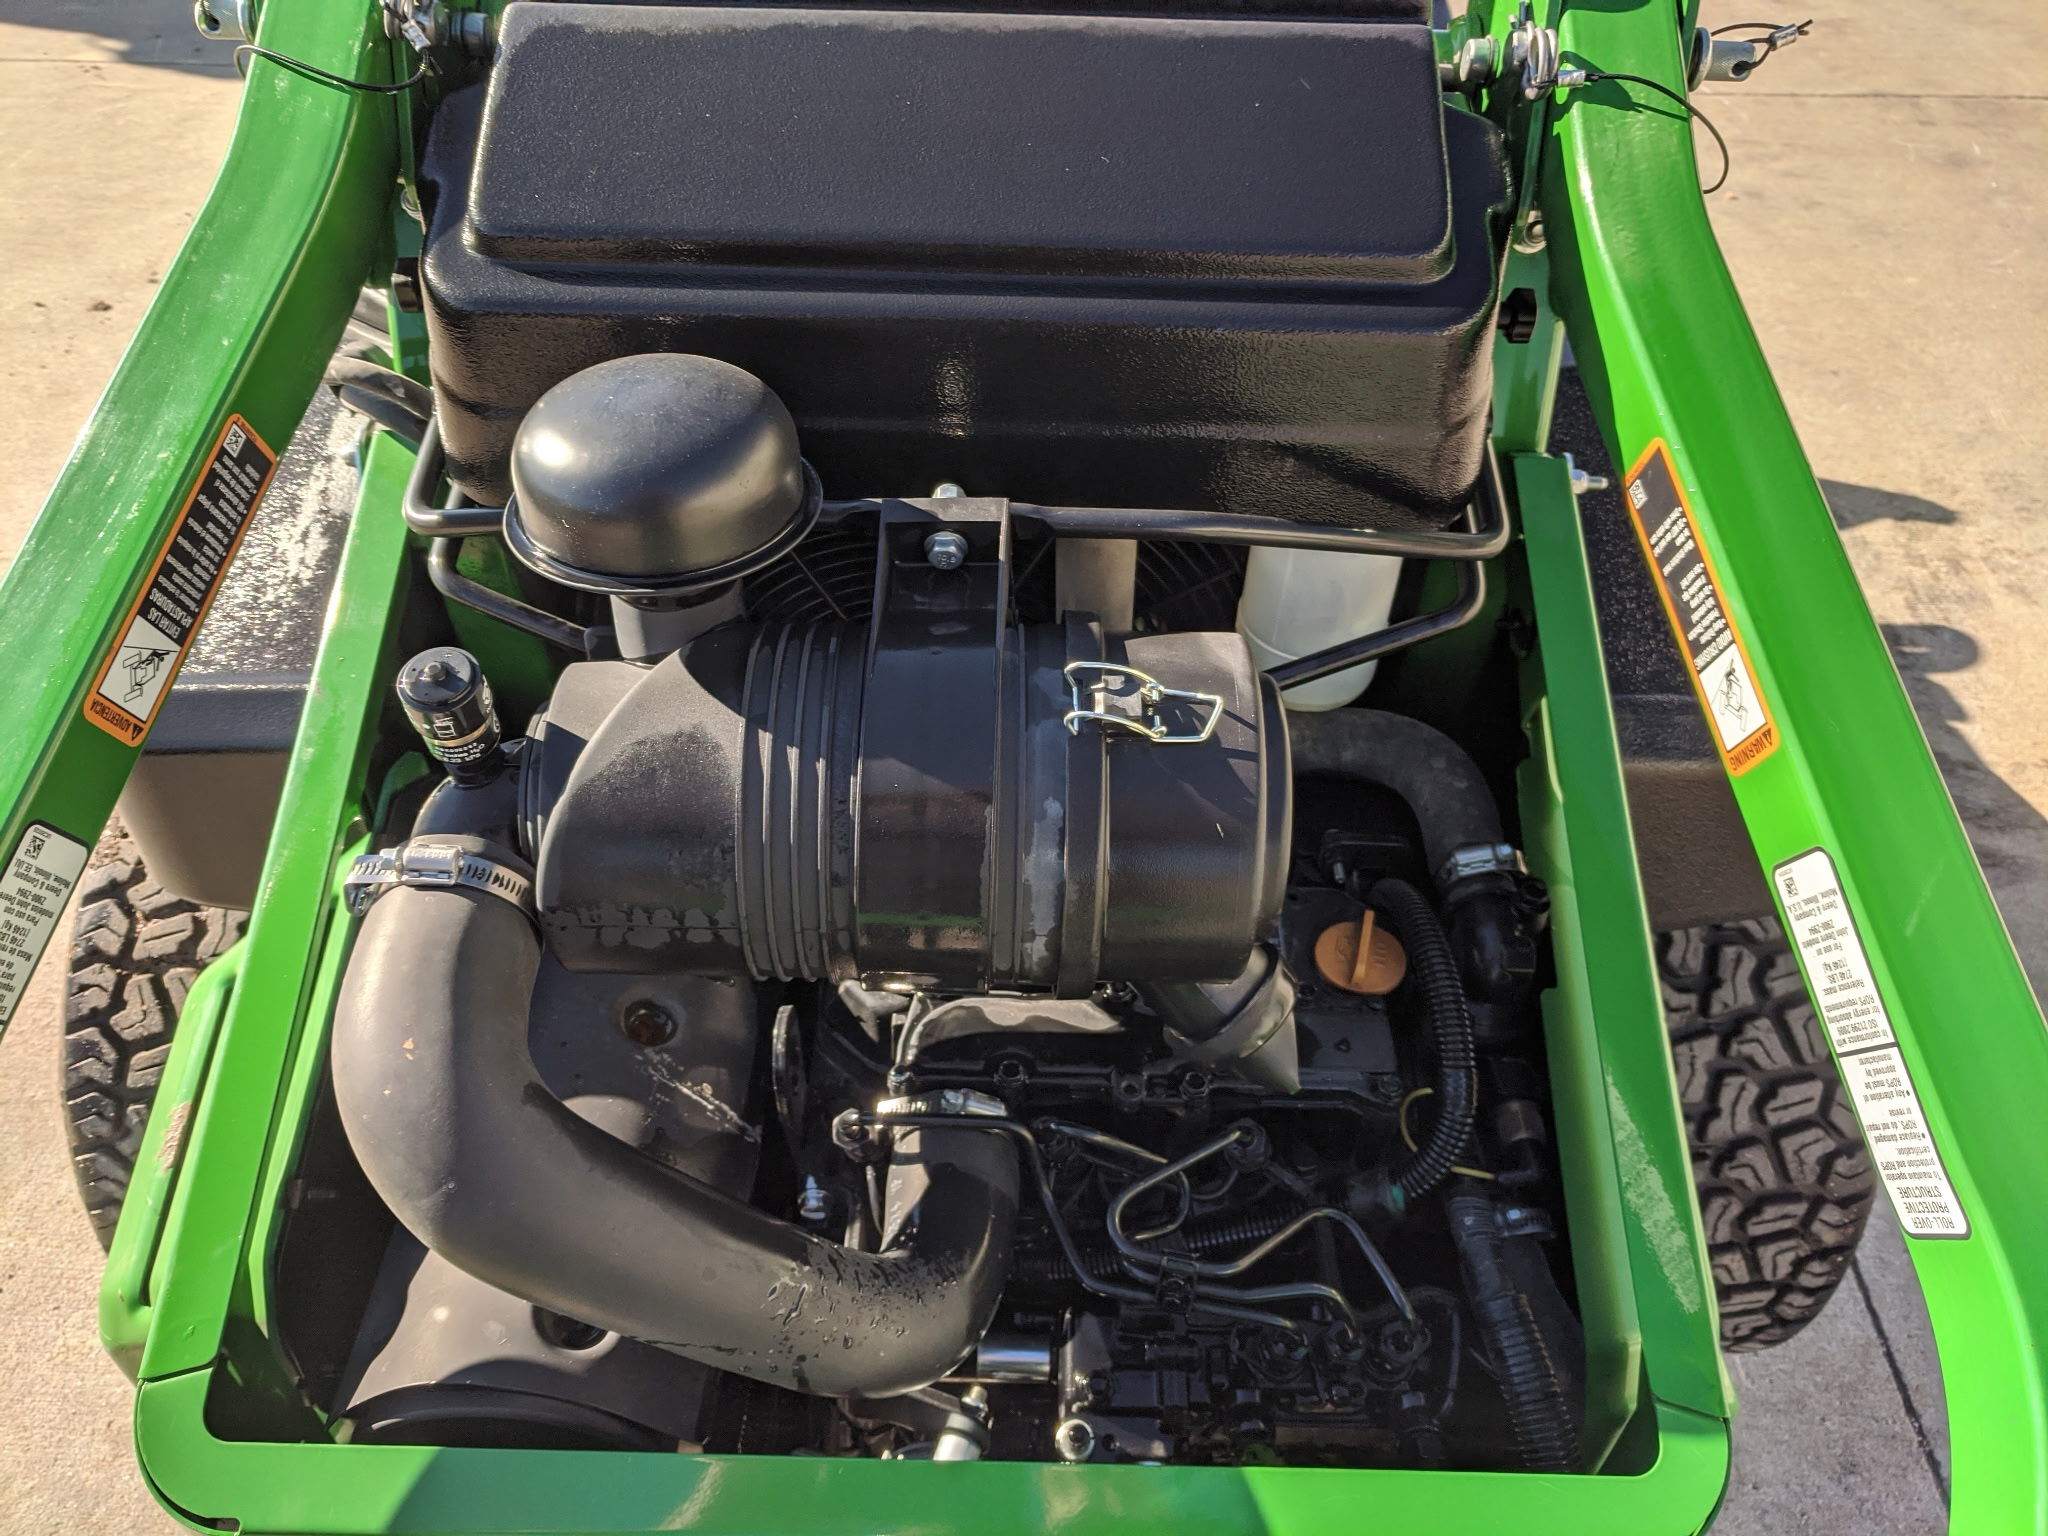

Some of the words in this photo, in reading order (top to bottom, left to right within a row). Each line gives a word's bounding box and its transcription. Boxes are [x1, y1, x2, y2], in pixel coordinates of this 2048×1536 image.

[149, 588, 192, 628] APLASTADURAS
[159, 616, 181, 638] EVITAR
[90, 698, 132, 732] ADVERTENCIA
[1729, 736, 1766, 771] WARNING
[13, 868, 40, 887] Company
[45, 884, 62, 897] Deere
[16, 899, 30, 910] John
[1821, 900, 1838, 911] Deere
[3, 906, 15, 915] con
[14, 910, 26, 919] uso
[30, 904, 54, 918] modelos
[26, 914, 40, 926] Para
[1820, 931, 1836, 942] Deere
[1836, 926, 1848, 937] John
[9, 936, 25, 948] 2746
[1833, 942, 1843, 950] For
[16, 950, 33, 962] Masa
[1858, 994, 1875, 1006] ROPS
[1868, 1019, 1878, 1029] ISO
[1886, 1077, 1902, 1087] ROPS
[1895, 1088, 1906, 1097] Any
[1874, 1133, 1898, 1144] damaged
[1898, 1131, 1921, 1141] Replace
[1880, 1161, 1896, 1170] ROPS
[1895, 1160, 1906, 1169] and
[1897, 1186, 1942, 1198] STRUCTURE
[1903, 1201, 1949, 1213] PROTECTIVE
[1912, 1217, 1955, 1228] ROLL-OVER
